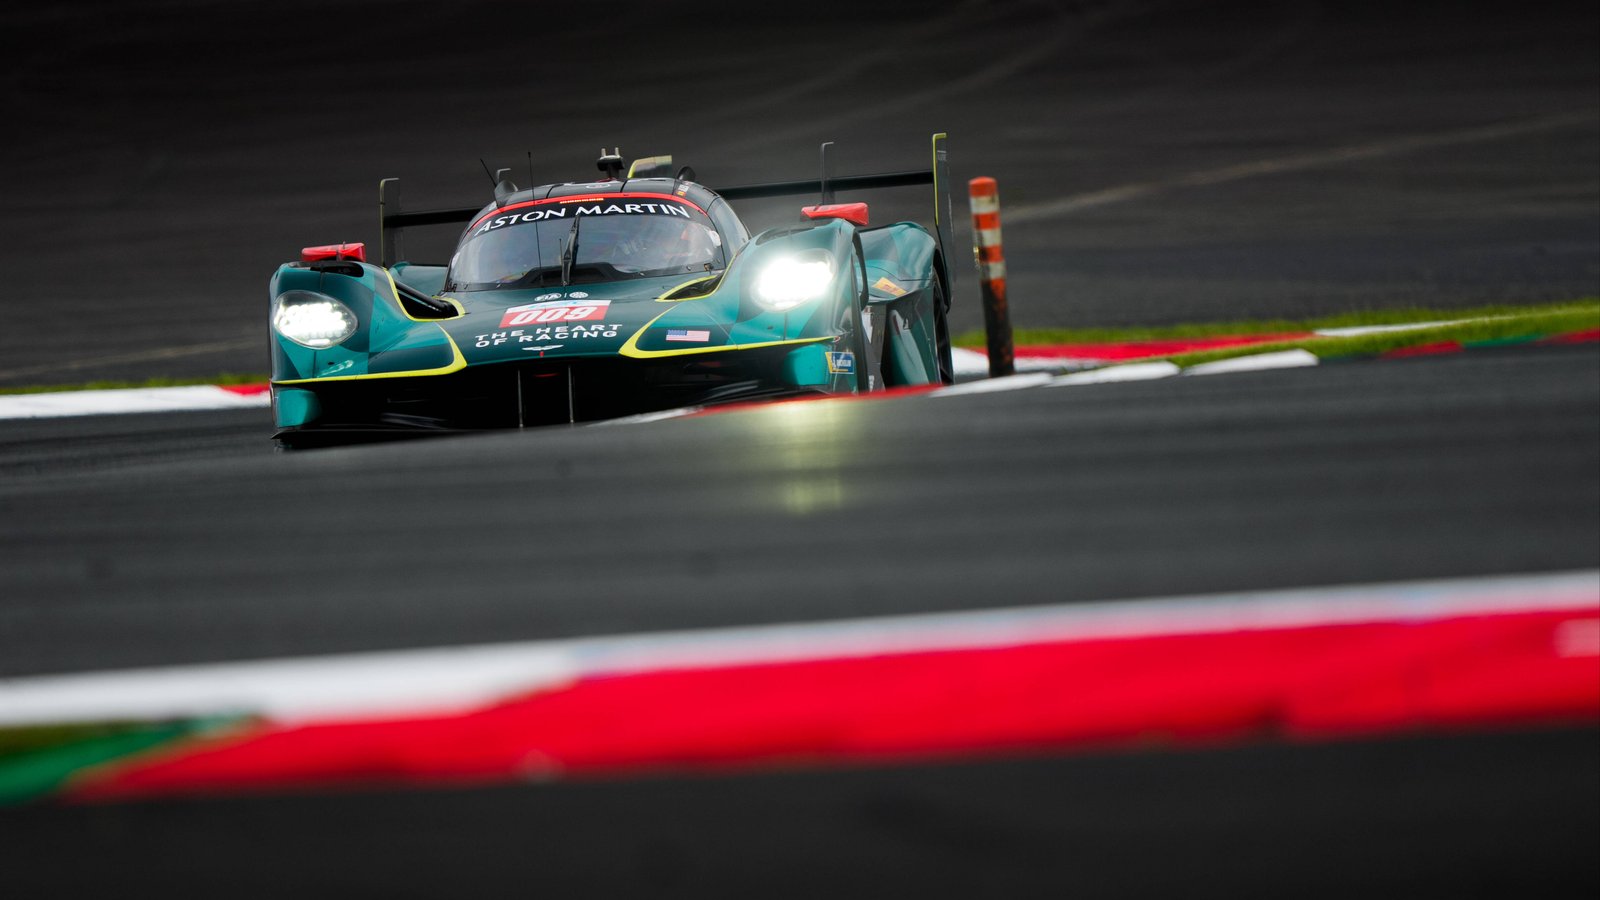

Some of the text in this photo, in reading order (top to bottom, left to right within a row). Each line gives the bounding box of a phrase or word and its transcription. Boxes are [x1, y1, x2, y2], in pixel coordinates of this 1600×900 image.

[474, 203, 690, 237] ASTON MARTIN
[509, 306, 597, 325] 009
[475, 324, 623, 341] THE HEART
[475, 331, 617, 348] OF RACING
